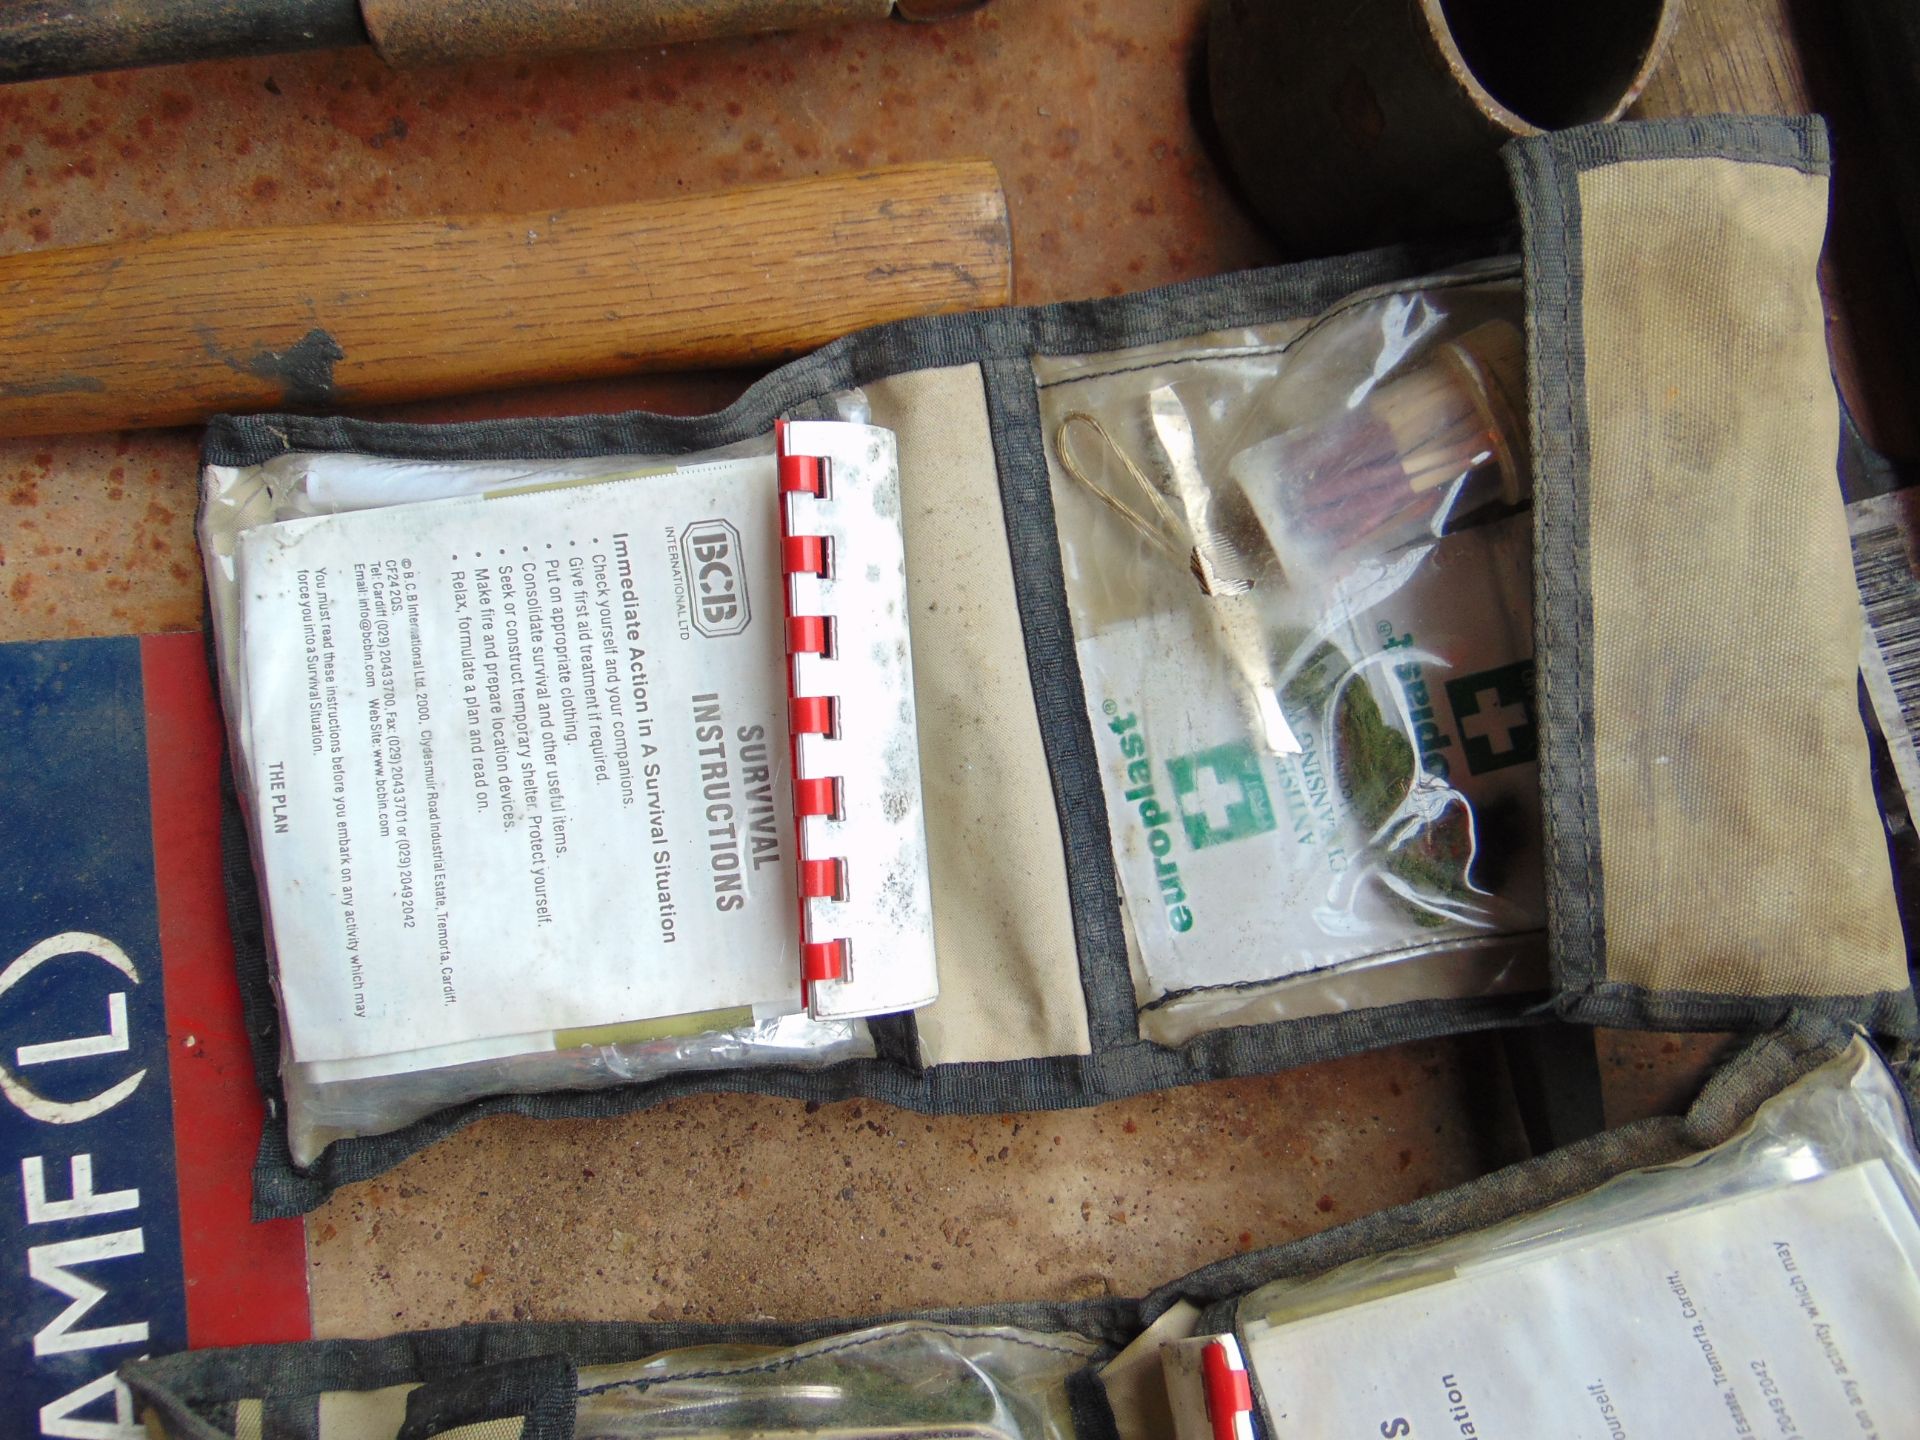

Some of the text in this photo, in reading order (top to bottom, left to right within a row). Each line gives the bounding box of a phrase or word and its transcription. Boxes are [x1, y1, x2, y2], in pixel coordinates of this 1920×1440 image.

[368, 560, 383, 580] Tel:
[371, 580, 388, 617] Cardiff
[384, 558, 400, 588] CF24
[663, 525, 690, 641] INTERNATIONAL LTD
[690, 531, 738, 624] BCB
[295, 568, 325, 756] force you into a Survival Situation.
[372, 618, 390, 648] (029)
[378, 648, 393, 678] 2043
[543, 558, 579, 746] Put on appropriate clothing.
[352, 562, 390, 837] Email: info@bcbin.com Web Site: www.bcbin.com
[449, 570, 490, 814] Relax, formulate a plan and read on.
[473, 567, 516, 833] Make fire and prepare location devices.
[567, 556, 611, 786] Give first aid treatment if required.
[590, 553, 634, 809] Check yourself and your companions.
[520, 561, 568, 859] Consolidate survival and other useful items.
[611, 531, 677, 944] Immediate Action in A Survival Situation
[384, 734, 402, 765] (029)
[417, 729, 438, 791] Clydesmuir
[497, 564, 553, 927] Seek or construct temporary shelter. Protect yourself.
[267, 760, 289, 834] THE PLAN
[313, 566, 366, 1018] You must read these instructions before you embark on any activity which may
[390, 765, 406, 795] 2043
[392, 794, 408, 823] 3701
[426, 791, 441, 821] Road
[690, 692, 745, 912] INSTRUCTIONS
[735, 724, 780, 871] SURVIVAL
[393, 838, 412, 869] (029)
[395, 825, 407, 838] or
[429, 820, 446, 873] Industrial
[398, 869, 414, 899] 2049
[400, 898, 416, 929] 2042
[433, 872, 447, 910] Estate,
[1440, 1372, 1478, 1439] ation
